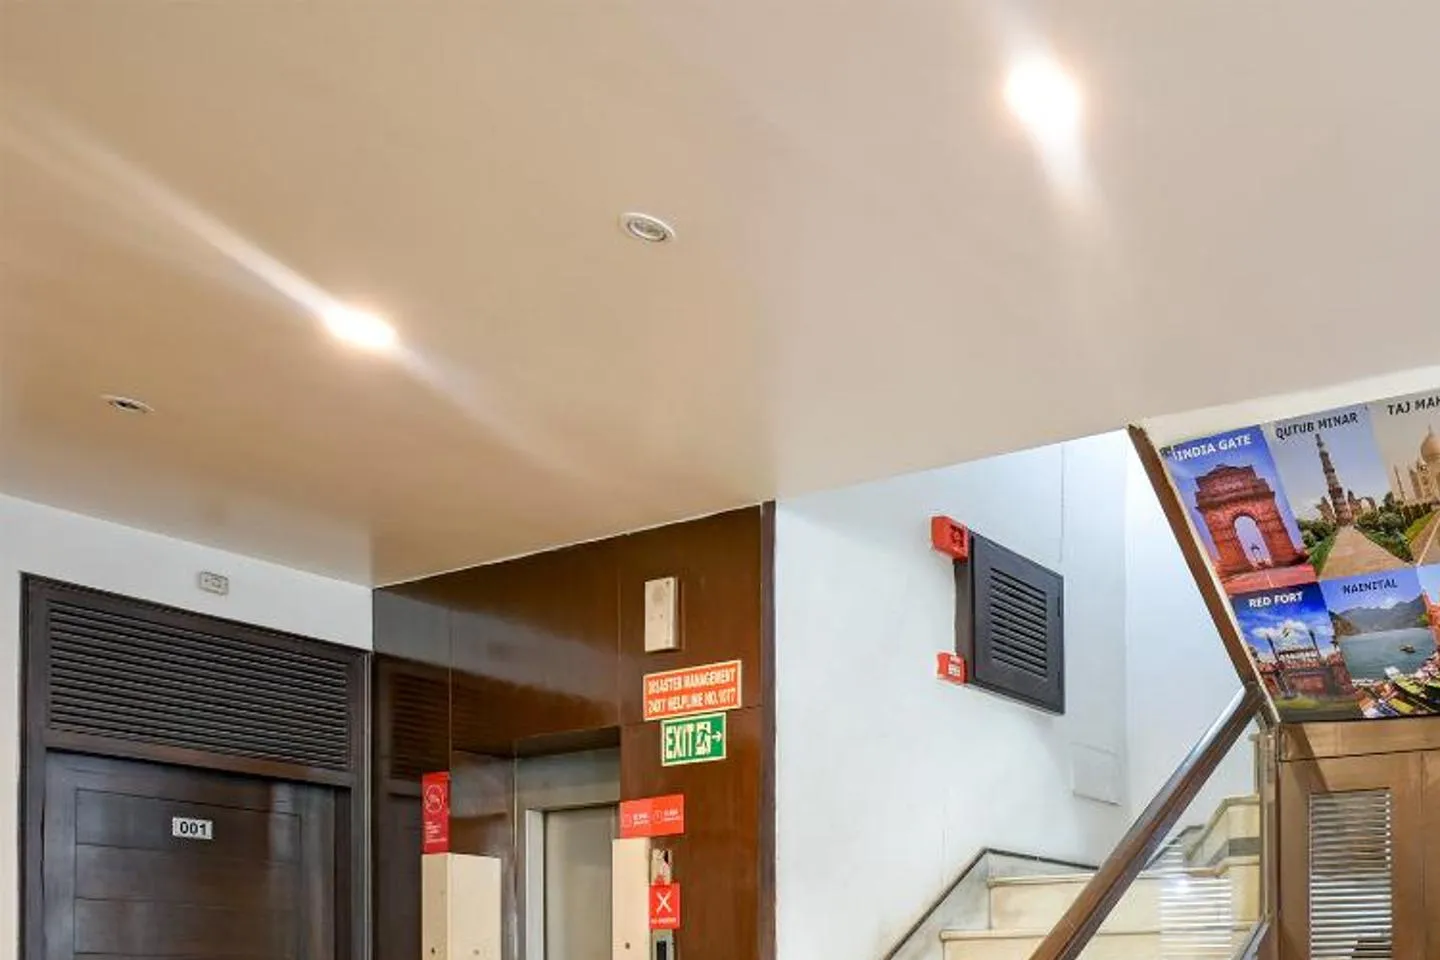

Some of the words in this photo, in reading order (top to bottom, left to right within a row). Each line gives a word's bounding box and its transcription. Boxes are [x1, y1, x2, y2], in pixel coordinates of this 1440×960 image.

[1388, 401, 1411, 416] TAJ
[1276, 423, 1314, 440] QUTUB
[1318, 412, 1358, 430] MINAR
[1175, 443, 1217, 462] INDIA
[1218, 434, 1253, 451] GATE
[1342, 578, 1399, 595] NAINITAL
[1248, 596, 1272, 608] RED
[1274, 591, 1304, 605] FORT
[665, 722, 695, 759] EXIT
[180, 821, 206, 836] 001
